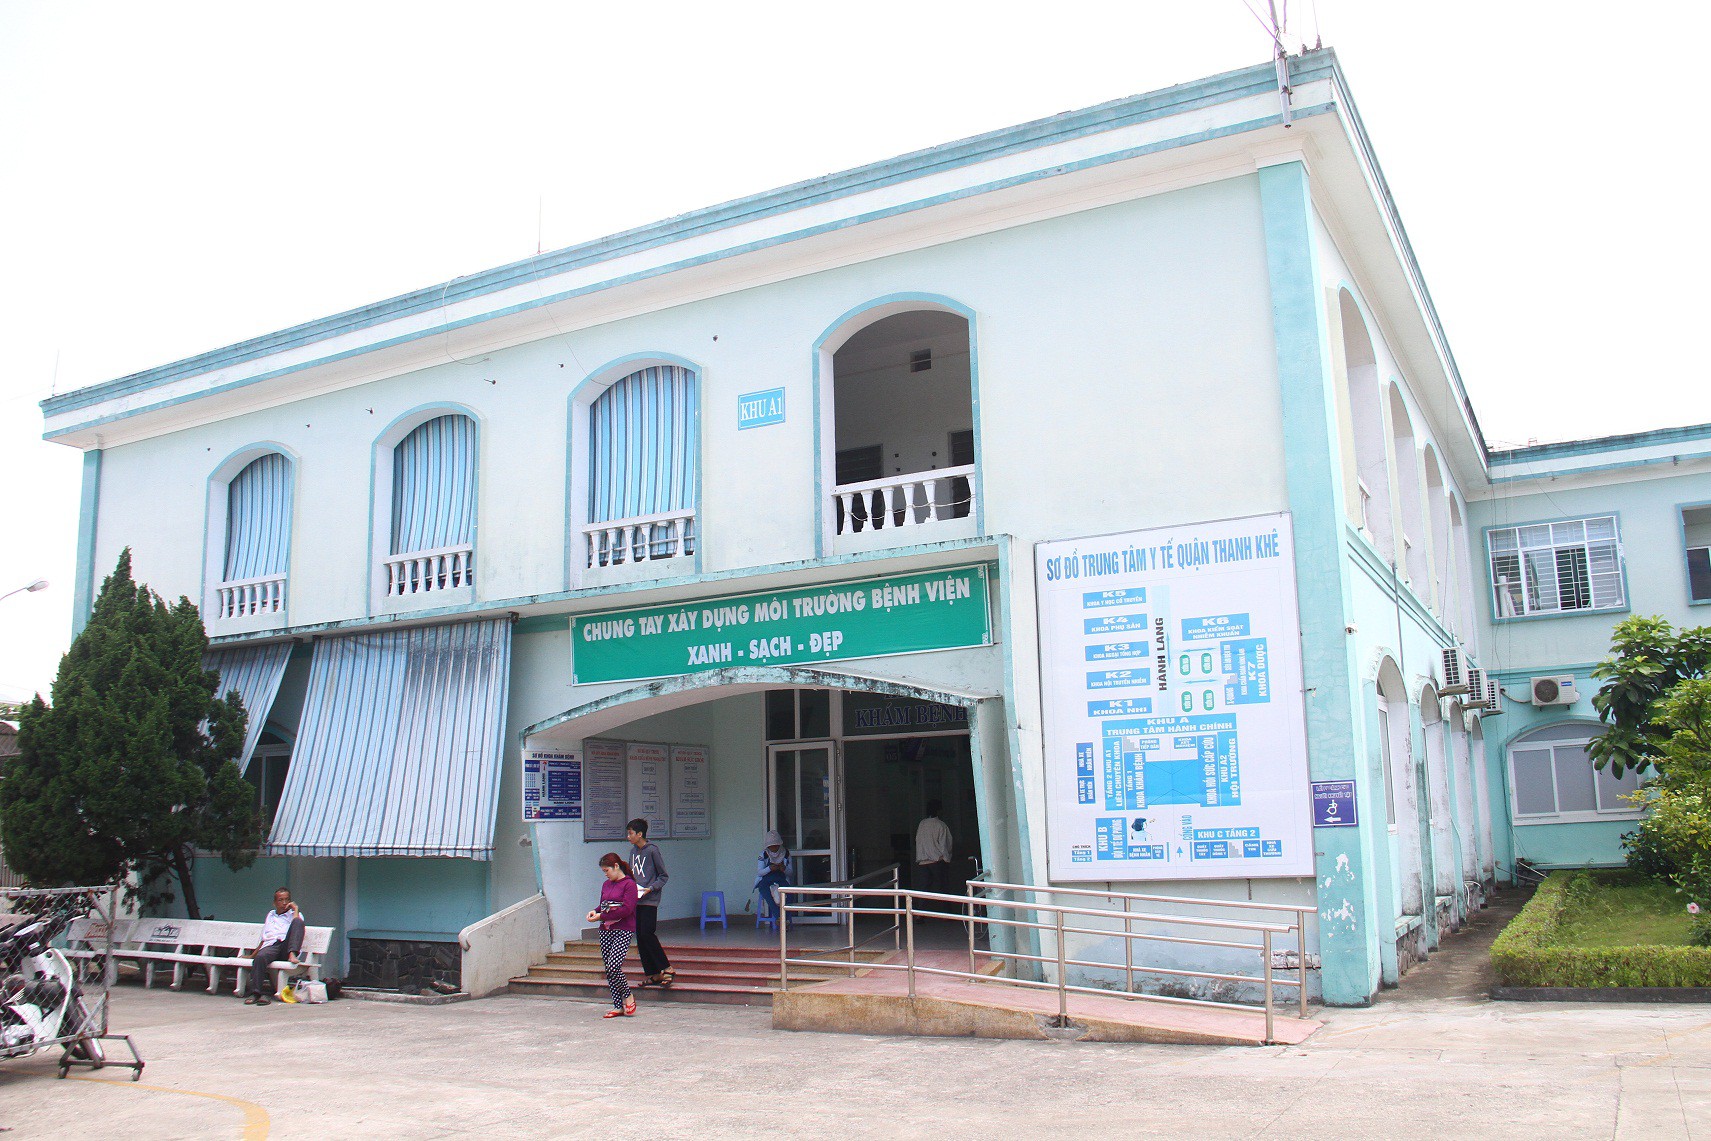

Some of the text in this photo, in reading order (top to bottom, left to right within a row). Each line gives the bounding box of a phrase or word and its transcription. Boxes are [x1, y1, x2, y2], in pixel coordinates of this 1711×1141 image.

[740, 396, 783, 421] KHU A1
[1047, 528, 1280, 581] SƠ ĐỒ TRUNG TÂM Y TẾ QUẬN THANH KHÊ
[1102, 590, 1126, 598] K5
[583, 574, 971, 642] CHUNG TAY XÂY DỰNG MÔI TRƯỜNG BỆNH VIỆN
[1103, 616, 1129, 625] K4
[1202, 616, 1230, 627] K6
[687, 642, 732, 666] XANH
[749, 635, 792, 663] SẠCH
[809, 630, 844, 657] ĐẸP
[1104, 643, 1130, 652] K3
[1155, 617, 1168, 691] HÀNH LANG
[1105, 670, 1132, 679] K2
[1247, 661, 1256, 681] K7
[1257, 671, 1267, 697] KHOA
[1093, 708, 1124, 716] KHOA
[1109, 699, 1133, 708] K1
[854, 702, 968, 729] KHÁM BỆNH
[1146, 717, 1175, 725] KHU
[1106, 721, 1233, 736] TRUNG TÂM HÀNH CHÍNH
[1105, 749, 1112, 758] A1
[1113, 740, 1123, 807] LIÊN CHUYÊN KHOA
[1219, 754, 1228, 783] KHU A2
[1132, 753, 1145, 808] KHOA KHÁM BỆNH
[1230, 780, 1240, 798] HỘI
[1197, 827, 1256, 839] KHU C TẦNG 2
[1097, 834, 1109, 852] KHU
